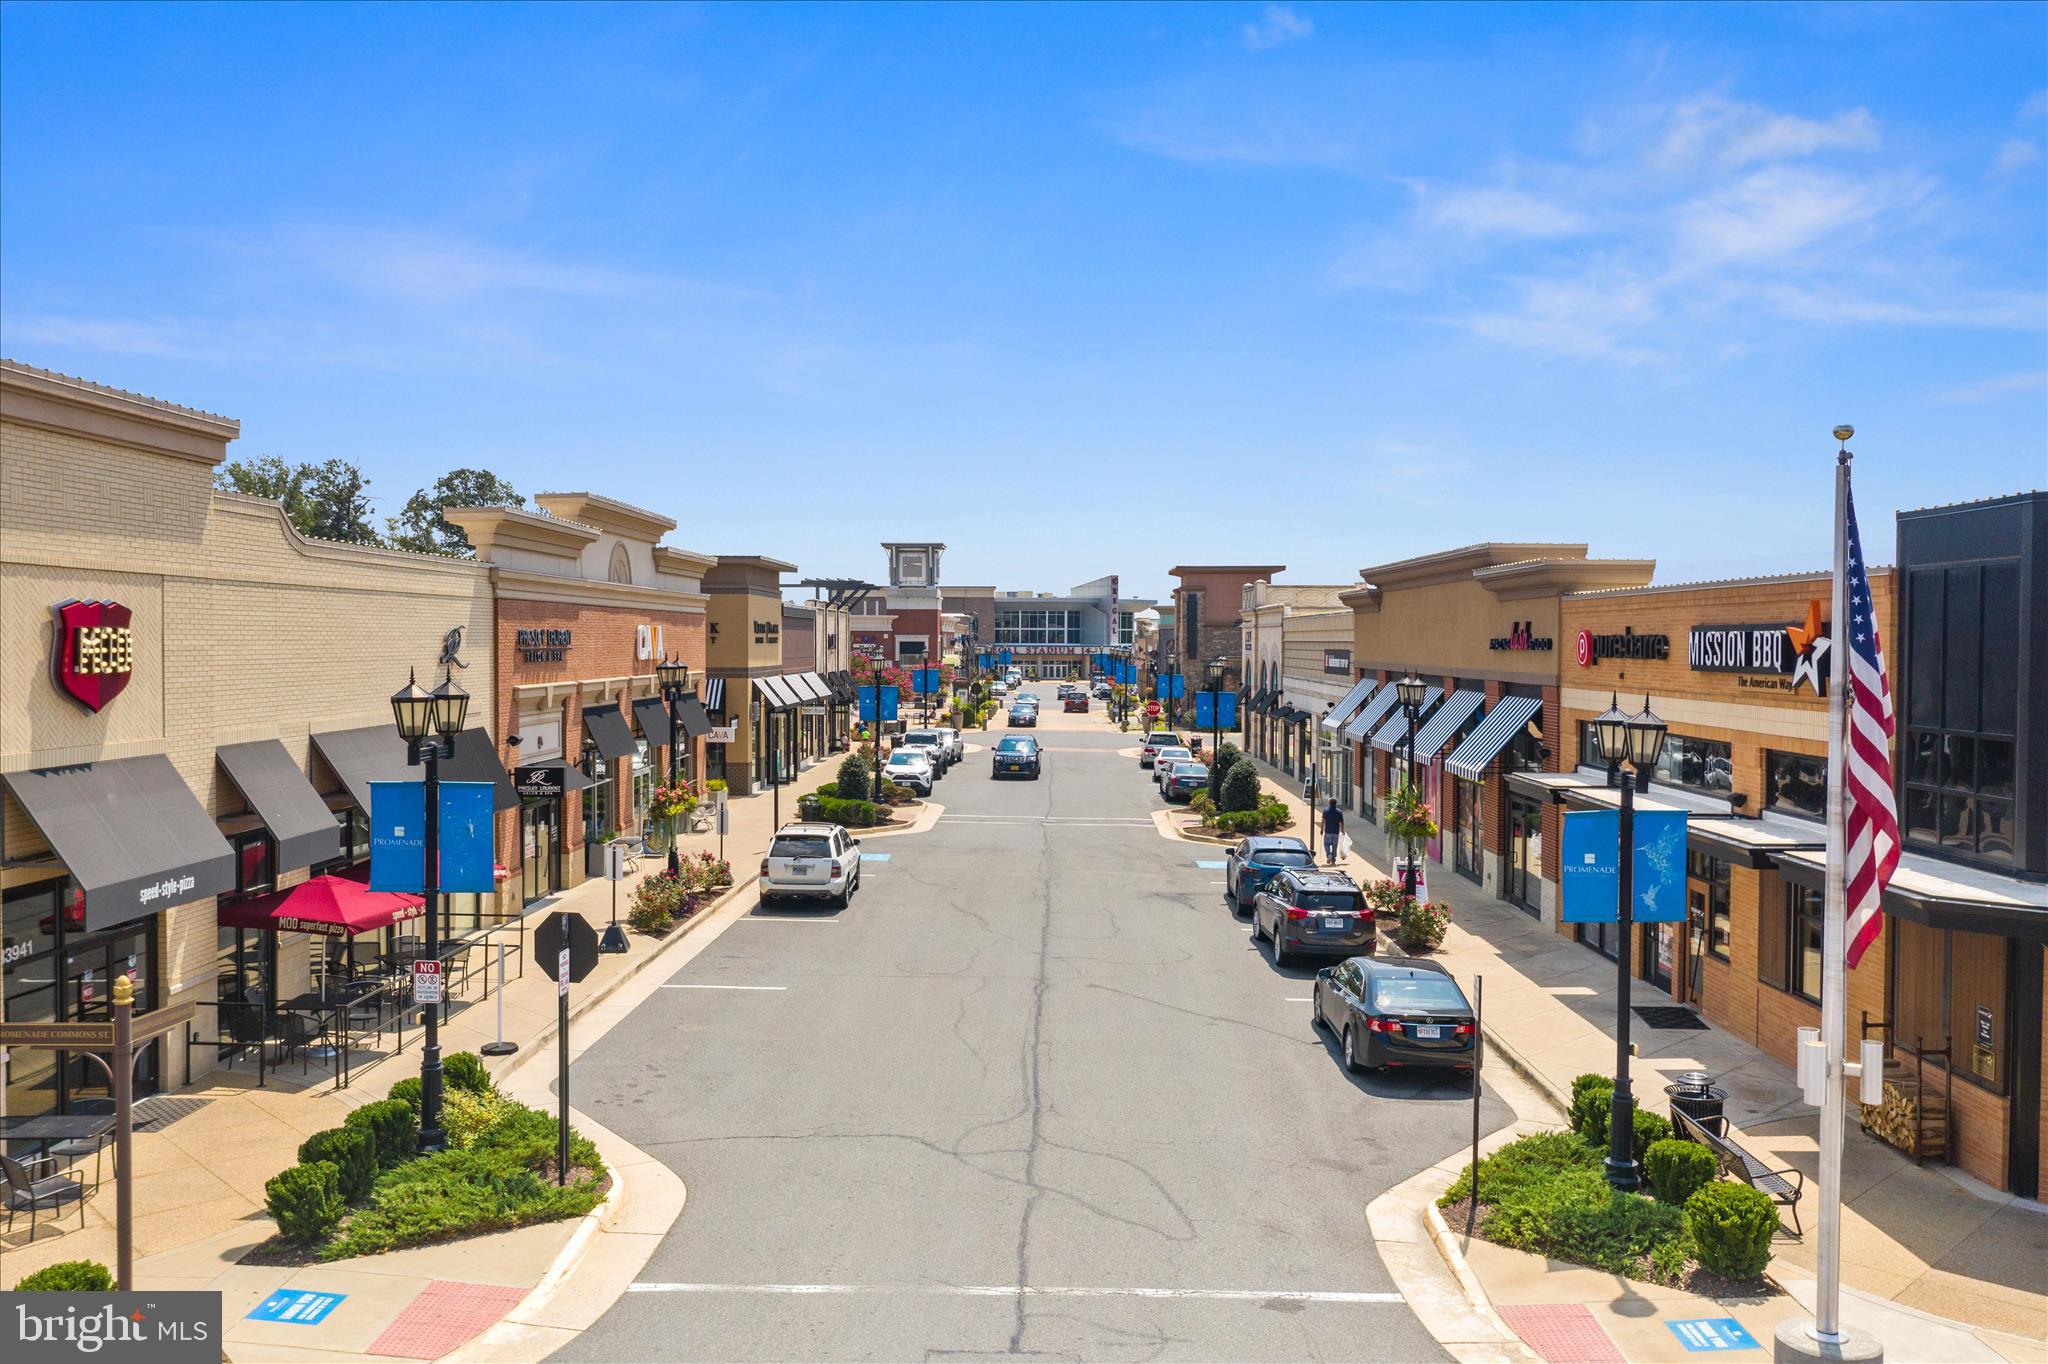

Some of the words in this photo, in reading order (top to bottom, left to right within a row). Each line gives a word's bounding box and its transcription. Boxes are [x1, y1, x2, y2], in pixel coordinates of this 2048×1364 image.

[80, 627, 132, 673] MOD
[637, 624, 664, 660] CAVA
[1592, 634, 1622, 666] pure
[1622, 626, 1669, 661] barre
[1688, 630, 1745, 667] MISSION
[1752, 630, 1782, 673] BBQ
[1738, 676, 1749, 688] The
[1749, 677, 1778, 690] American
[1778, 678, 1794, 692] Way
[708, 731, 729, 740] CAVA
[373, 838, 423, 847] PROMENADE
[1563, 865, 1617, 875] PROMENADE
[279, 916, 298, 930] MOD
[299, 920, 328, 932] superfast
[328, 923, 344, 934] pizza
[420, 962, 435, 973] NO
[0, 1030, 49, 1039] ROMENADE
[50, 1030, 97, 1039] COMMONS
[98, 1030, 111, 1039] ST.
